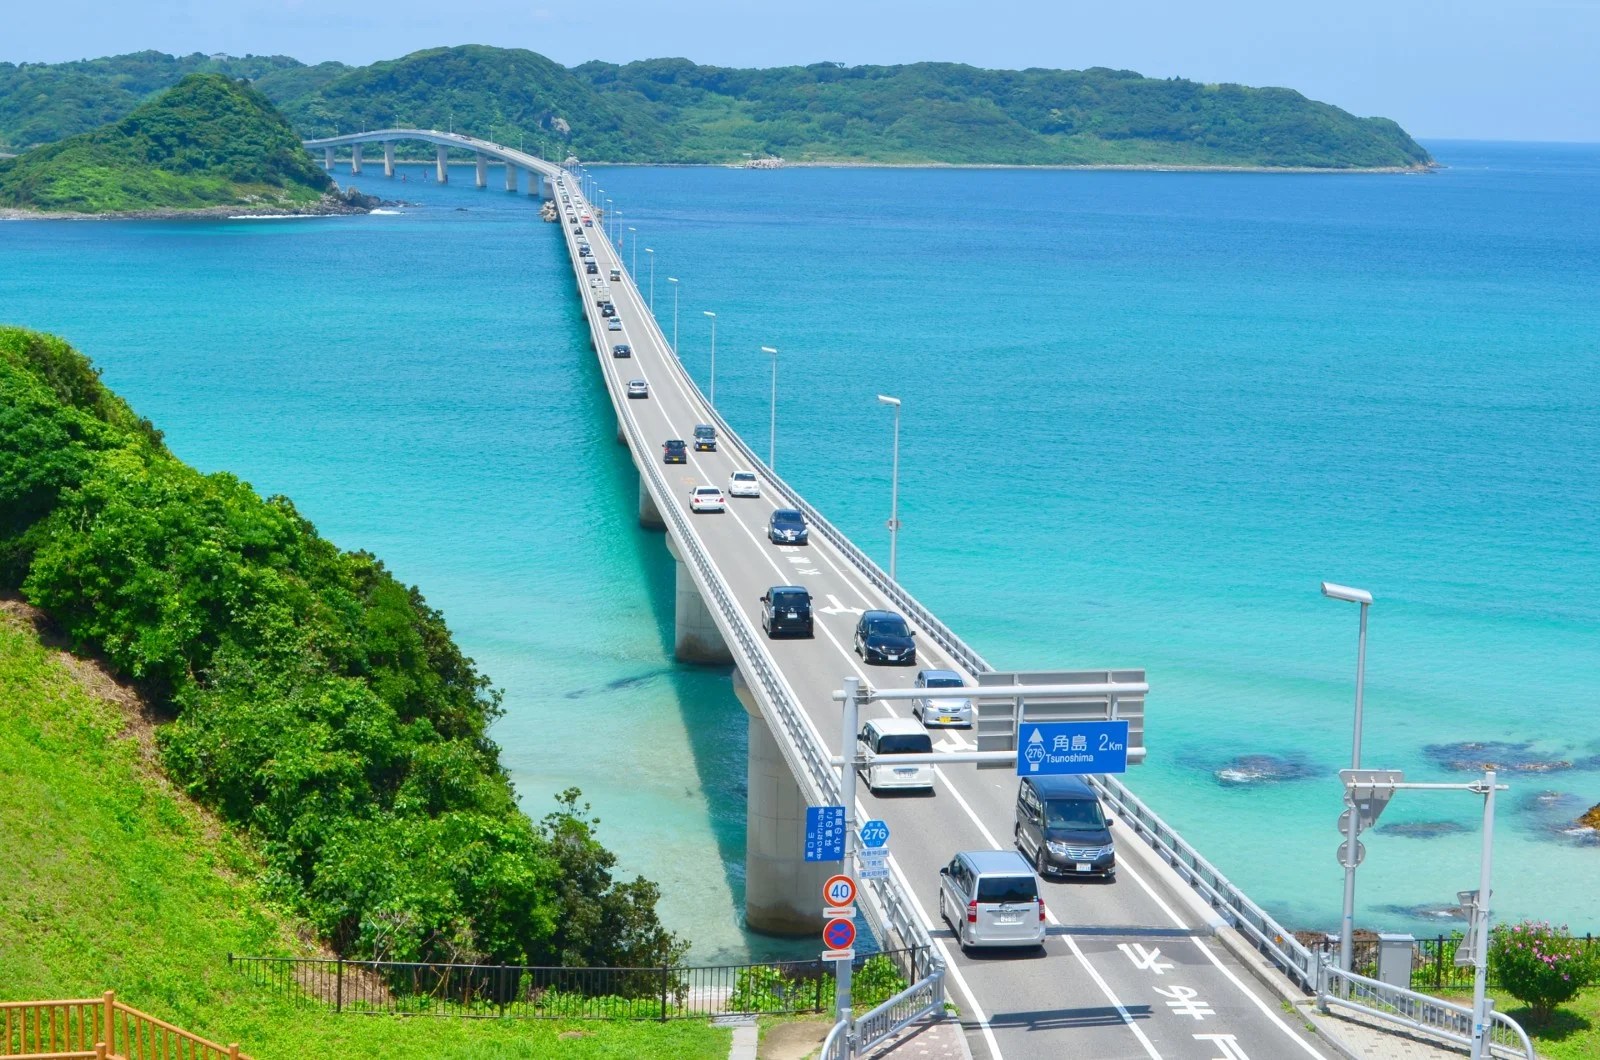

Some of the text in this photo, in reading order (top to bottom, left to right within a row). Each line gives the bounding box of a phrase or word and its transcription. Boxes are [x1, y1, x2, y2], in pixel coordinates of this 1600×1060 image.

[1053, 734, 1087, 752] 角島
[1028, 748, 1042, 759] 276
[1045, 753, 1094, 763] Tsunoshima
[863, 828, 887, 840] 276
[831, 884, 849, 898] 40
